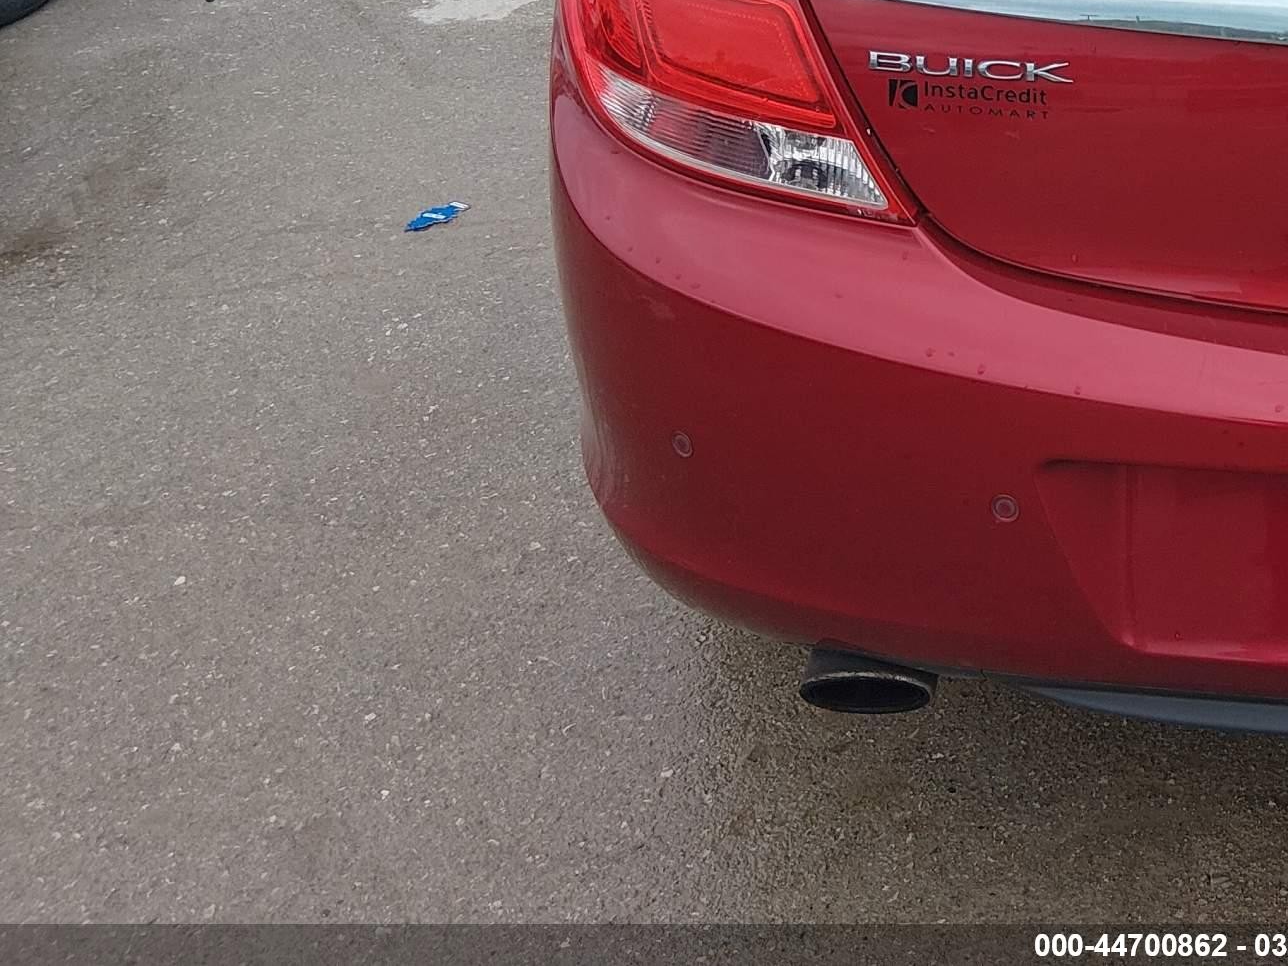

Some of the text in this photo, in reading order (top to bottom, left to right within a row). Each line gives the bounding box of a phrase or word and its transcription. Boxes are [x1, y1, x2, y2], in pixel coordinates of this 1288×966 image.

[868, 50, 1074, 83] BUICK
[924, 80, 1048, 106] InstaCredit
[924, 103, 1049, 120] AUTOMART
